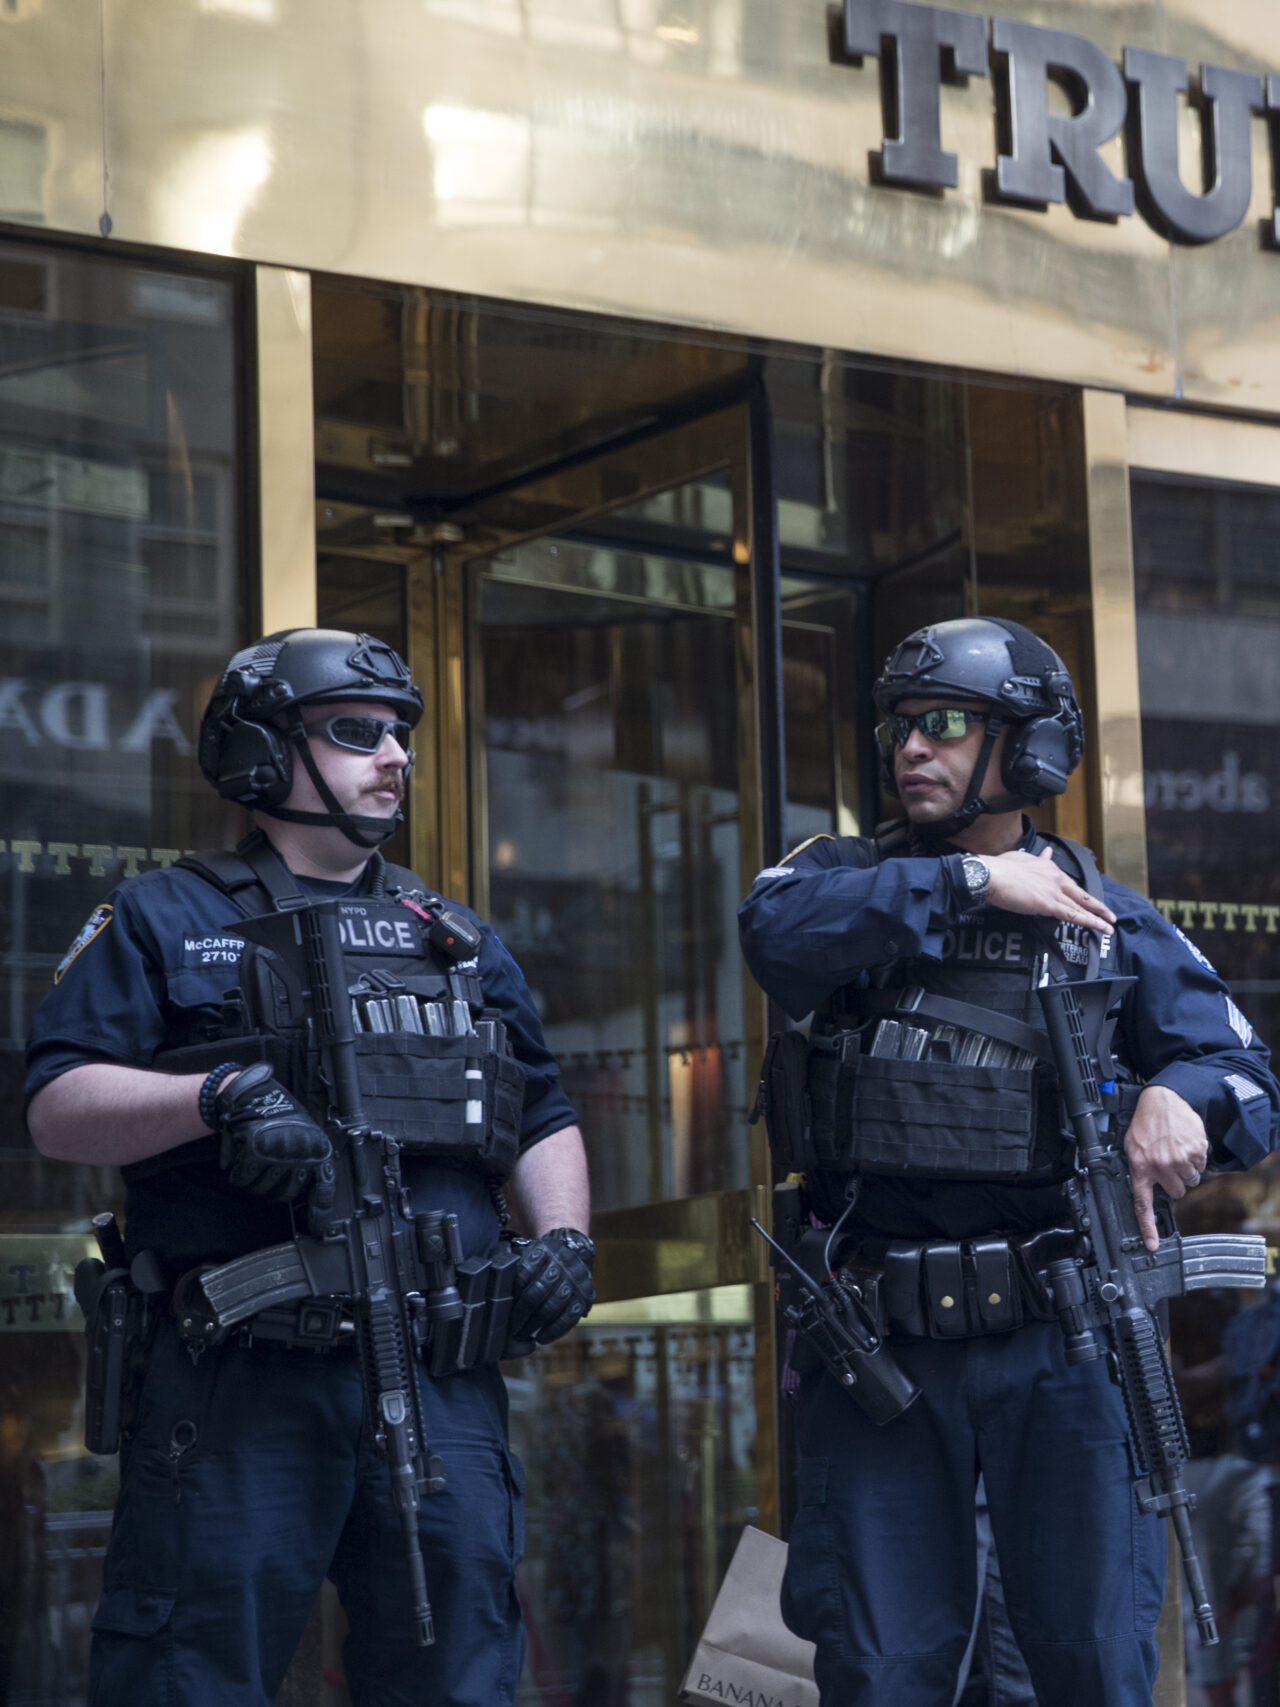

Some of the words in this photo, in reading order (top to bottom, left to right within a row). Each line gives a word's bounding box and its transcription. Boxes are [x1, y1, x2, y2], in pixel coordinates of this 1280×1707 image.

[340, 905, 367, 916] NYPD
[338, 918, 415, 949] LICE
[184, 937, 246, 951] McCAFFR
[943, 930, 1022, 962] OLICE
[201, 950, 241, 963] 2710
